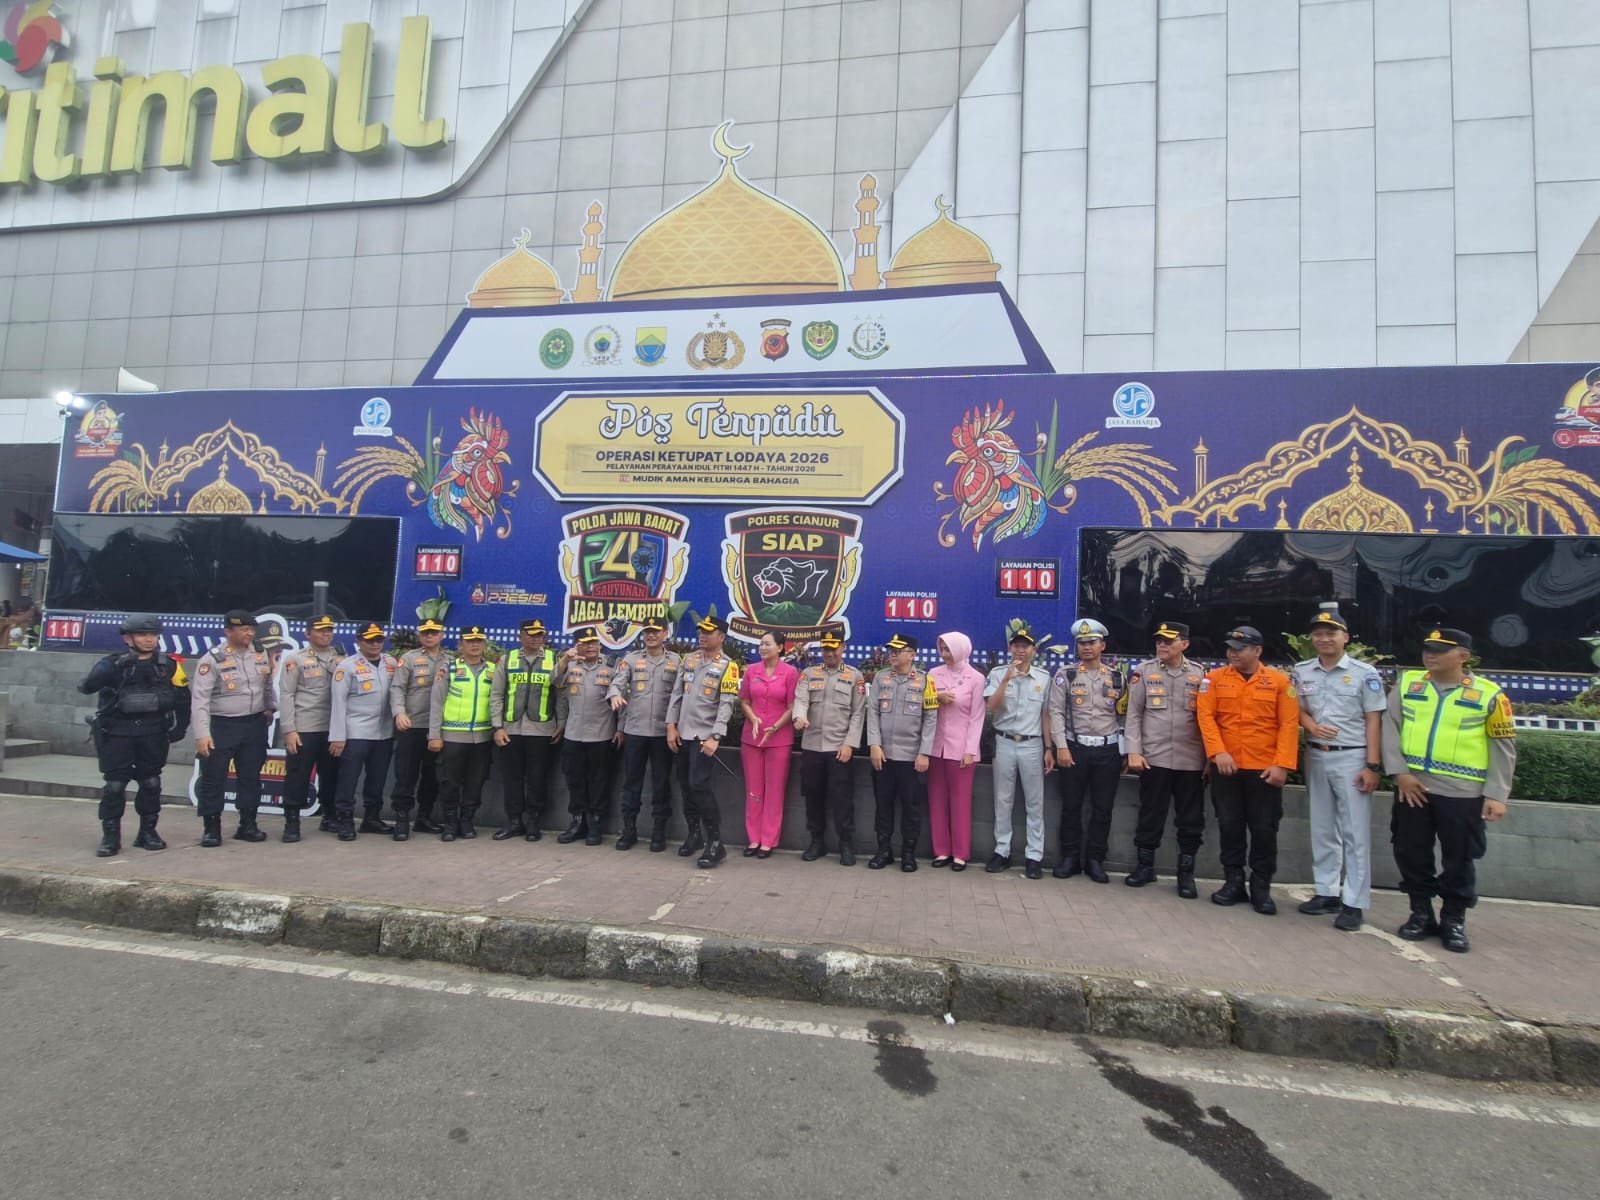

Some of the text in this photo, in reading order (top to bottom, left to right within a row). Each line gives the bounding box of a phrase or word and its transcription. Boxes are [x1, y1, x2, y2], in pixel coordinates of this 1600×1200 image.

[0, 15, 447, 186] itimall
[596, 451, 829, 464] OPERASI KETUPAT LODAYA 2026
[666, 475, 696, 483] AMAN
[697, 476, 751, 484] KELUARGA
[752, 477, 800, 485] BAHAGIA
[571, 511, 681, 535] POLDA JAWA BARAT
[747, 514, 840, 529] POLRES CIANJUR
[762, 533, 824, 551] SIAP
[420, 555, 456, 572] 110
[1004, 570, 1051, 589] 110
[488, 592, 547, 603] PRESISI
[570, 599, 605, 624] JAGA
[889, 598, 934, 618] 110
[50, 621, 80, 638] 110
[732, 621, 748, 632] SETIA
